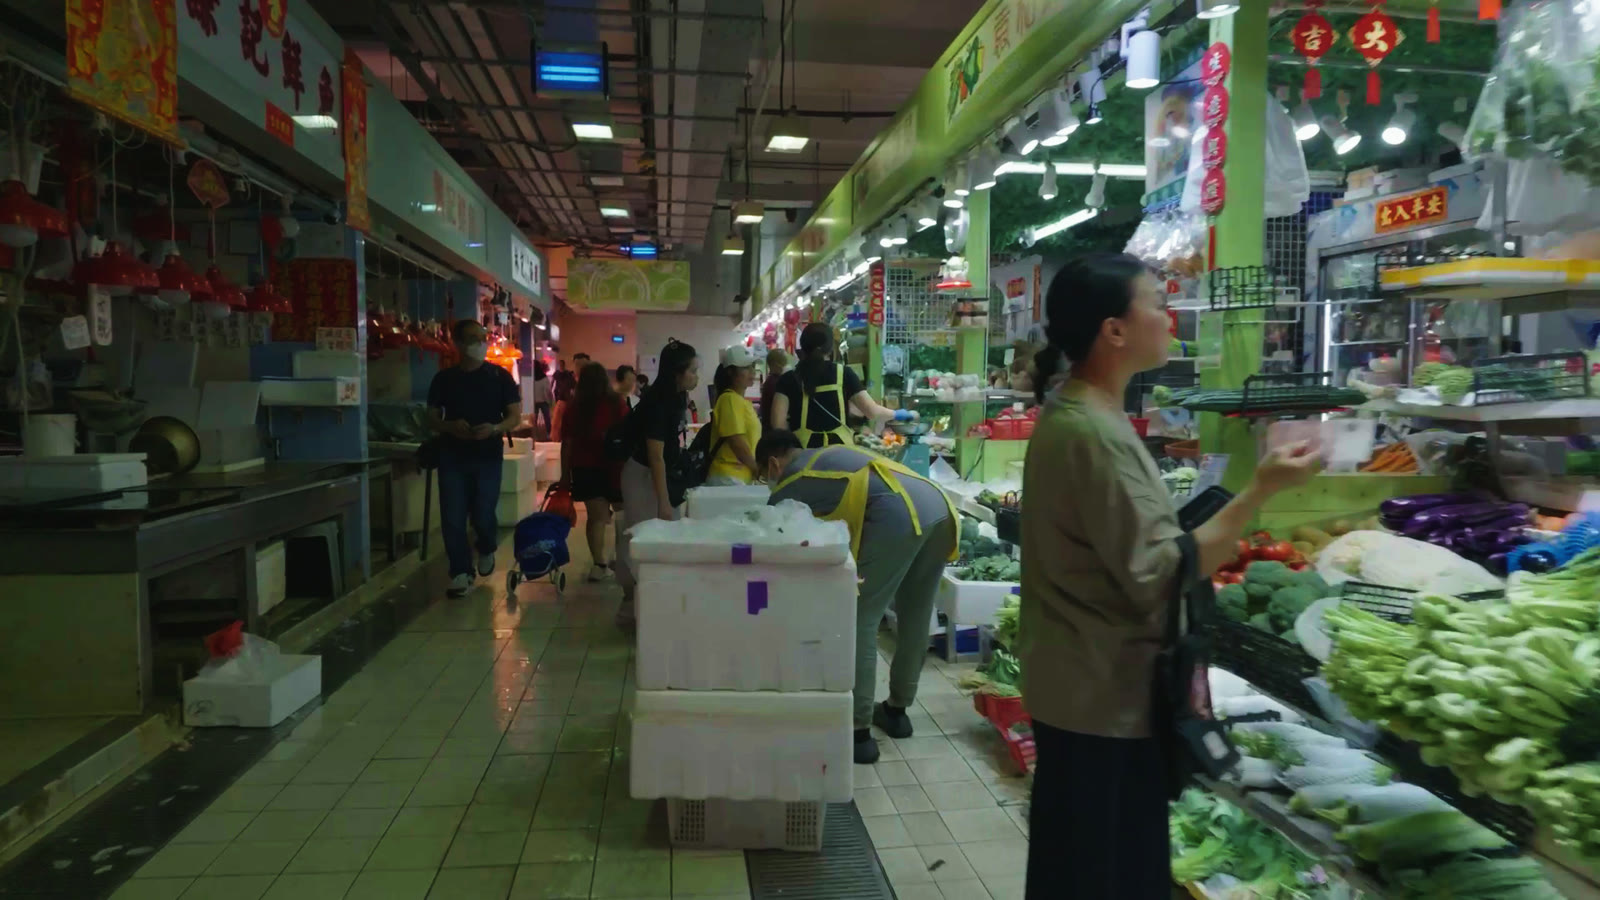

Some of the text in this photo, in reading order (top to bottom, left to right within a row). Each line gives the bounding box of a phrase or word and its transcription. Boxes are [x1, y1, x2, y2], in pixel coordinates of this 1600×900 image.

[1300, 24, 1327, 51] 吉
[1360, 21, 1388, 52] 大
[1380, 194, 1443, 226] 出入平安
